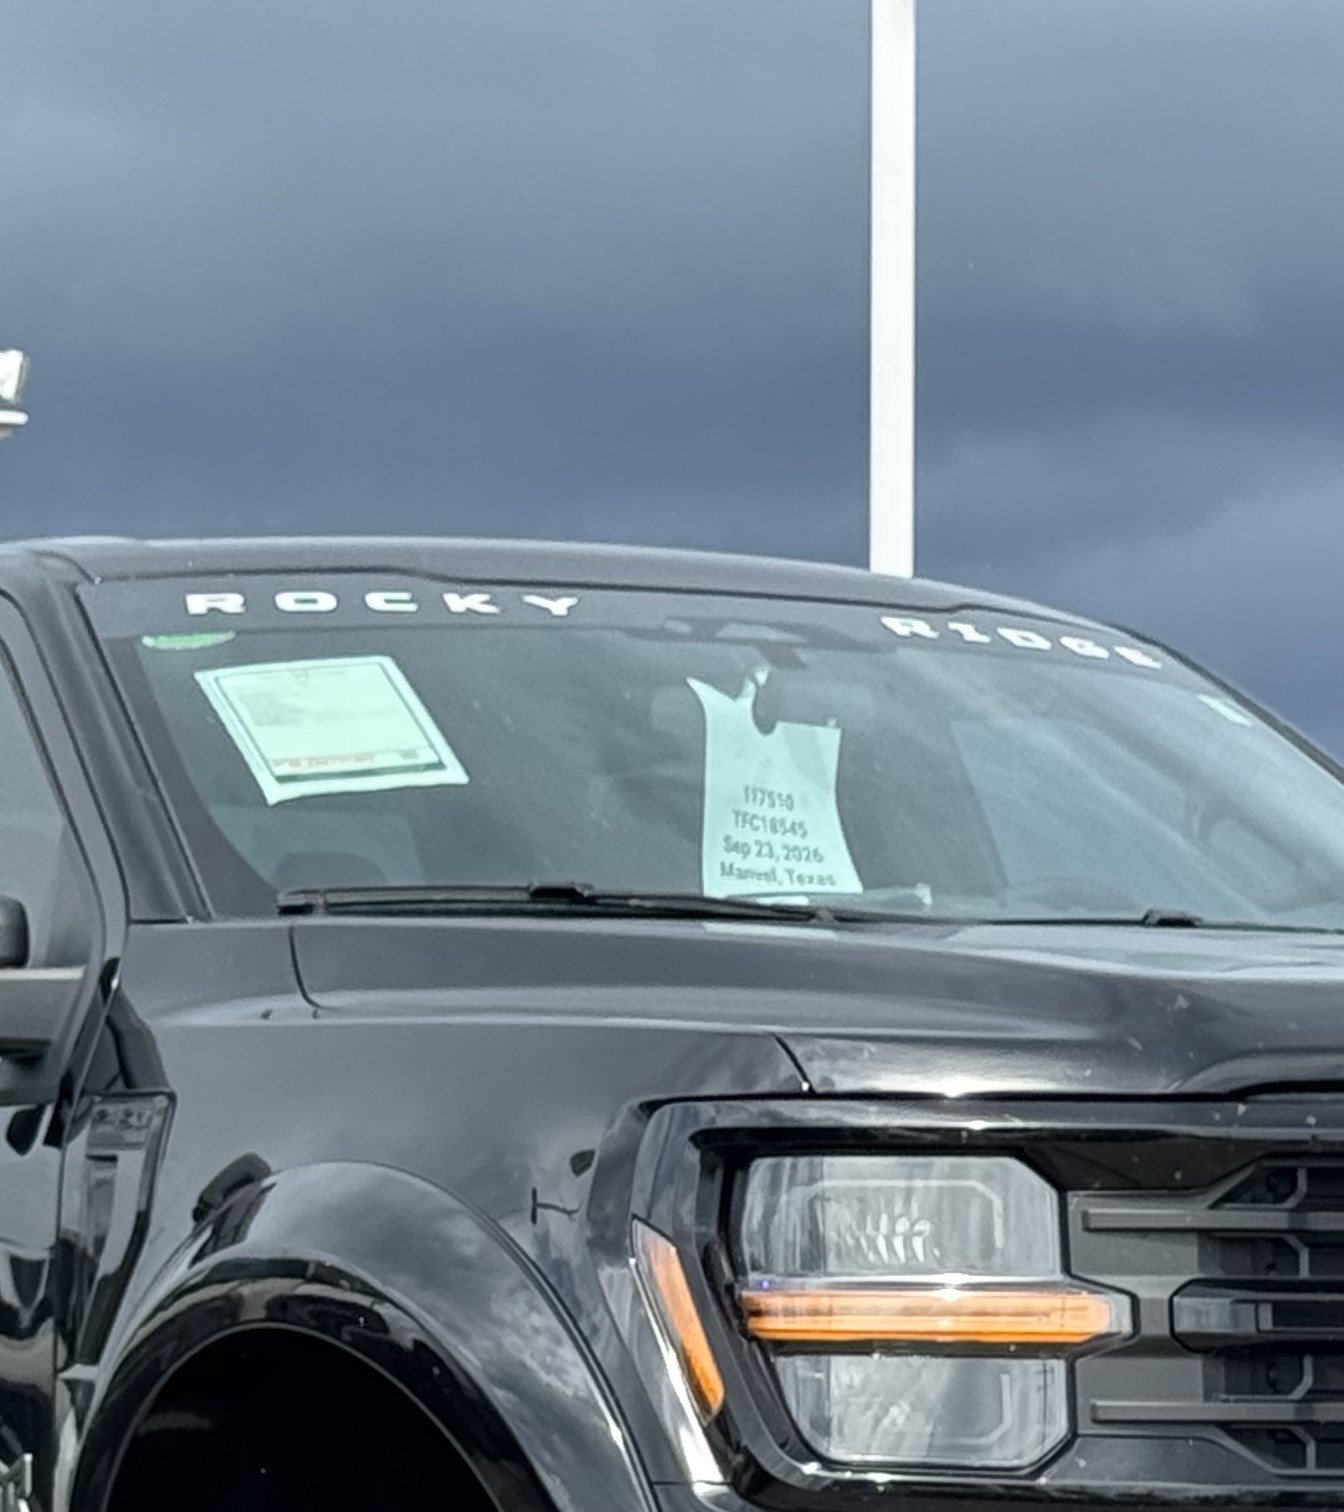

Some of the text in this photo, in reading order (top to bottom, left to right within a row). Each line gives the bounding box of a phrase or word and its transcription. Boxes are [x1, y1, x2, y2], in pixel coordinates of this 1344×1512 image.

[185, 591, 1163, 670] ROCKY RIDGE
[723, 834, 751, 860] Sep
[781, 843, 825, 863] 2026
[785, 867, 837, 887] Texas
